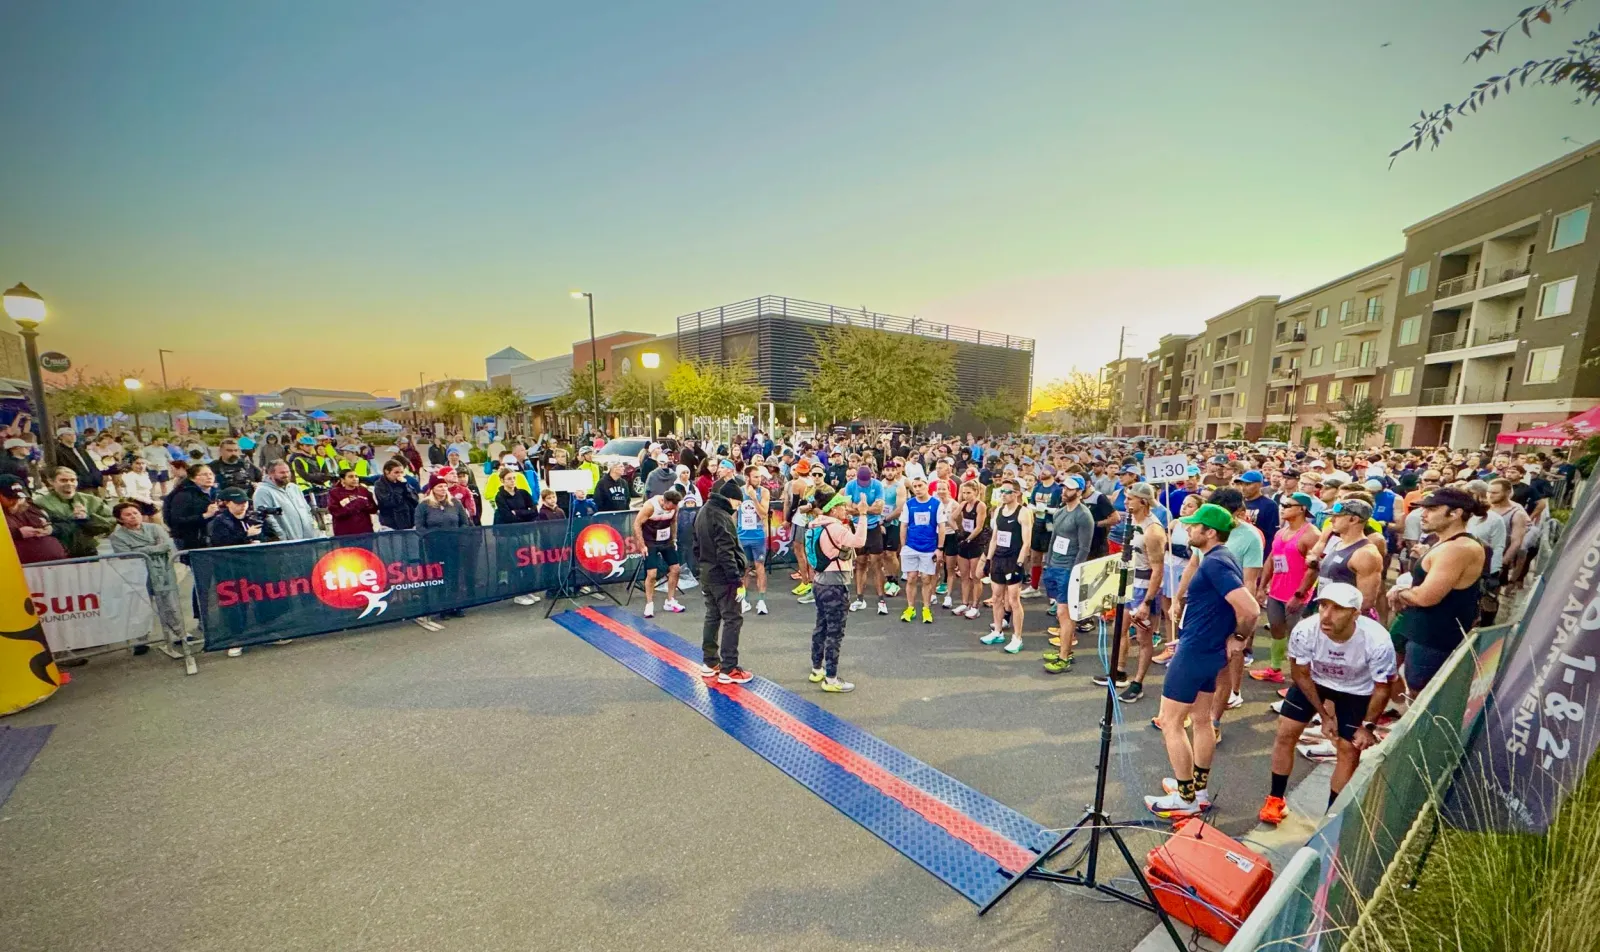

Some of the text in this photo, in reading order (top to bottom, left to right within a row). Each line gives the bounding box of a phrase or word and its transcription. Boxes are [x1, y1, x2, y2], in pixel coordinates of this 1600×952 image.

[1527, 437, 1558, 446] FIRST
[1151, 463, 1185, 479] 1:30
[583, 539, 619, 559] the
[216, 562, 443, 607] Shun the Sun
[390, 579, 445, 591] FOUNDATION
[39, 610, 101, 623] OUNDATION
[1507, 593, 1584, 757] APARTMENTS
[1545, 691, 1584, 722] &
